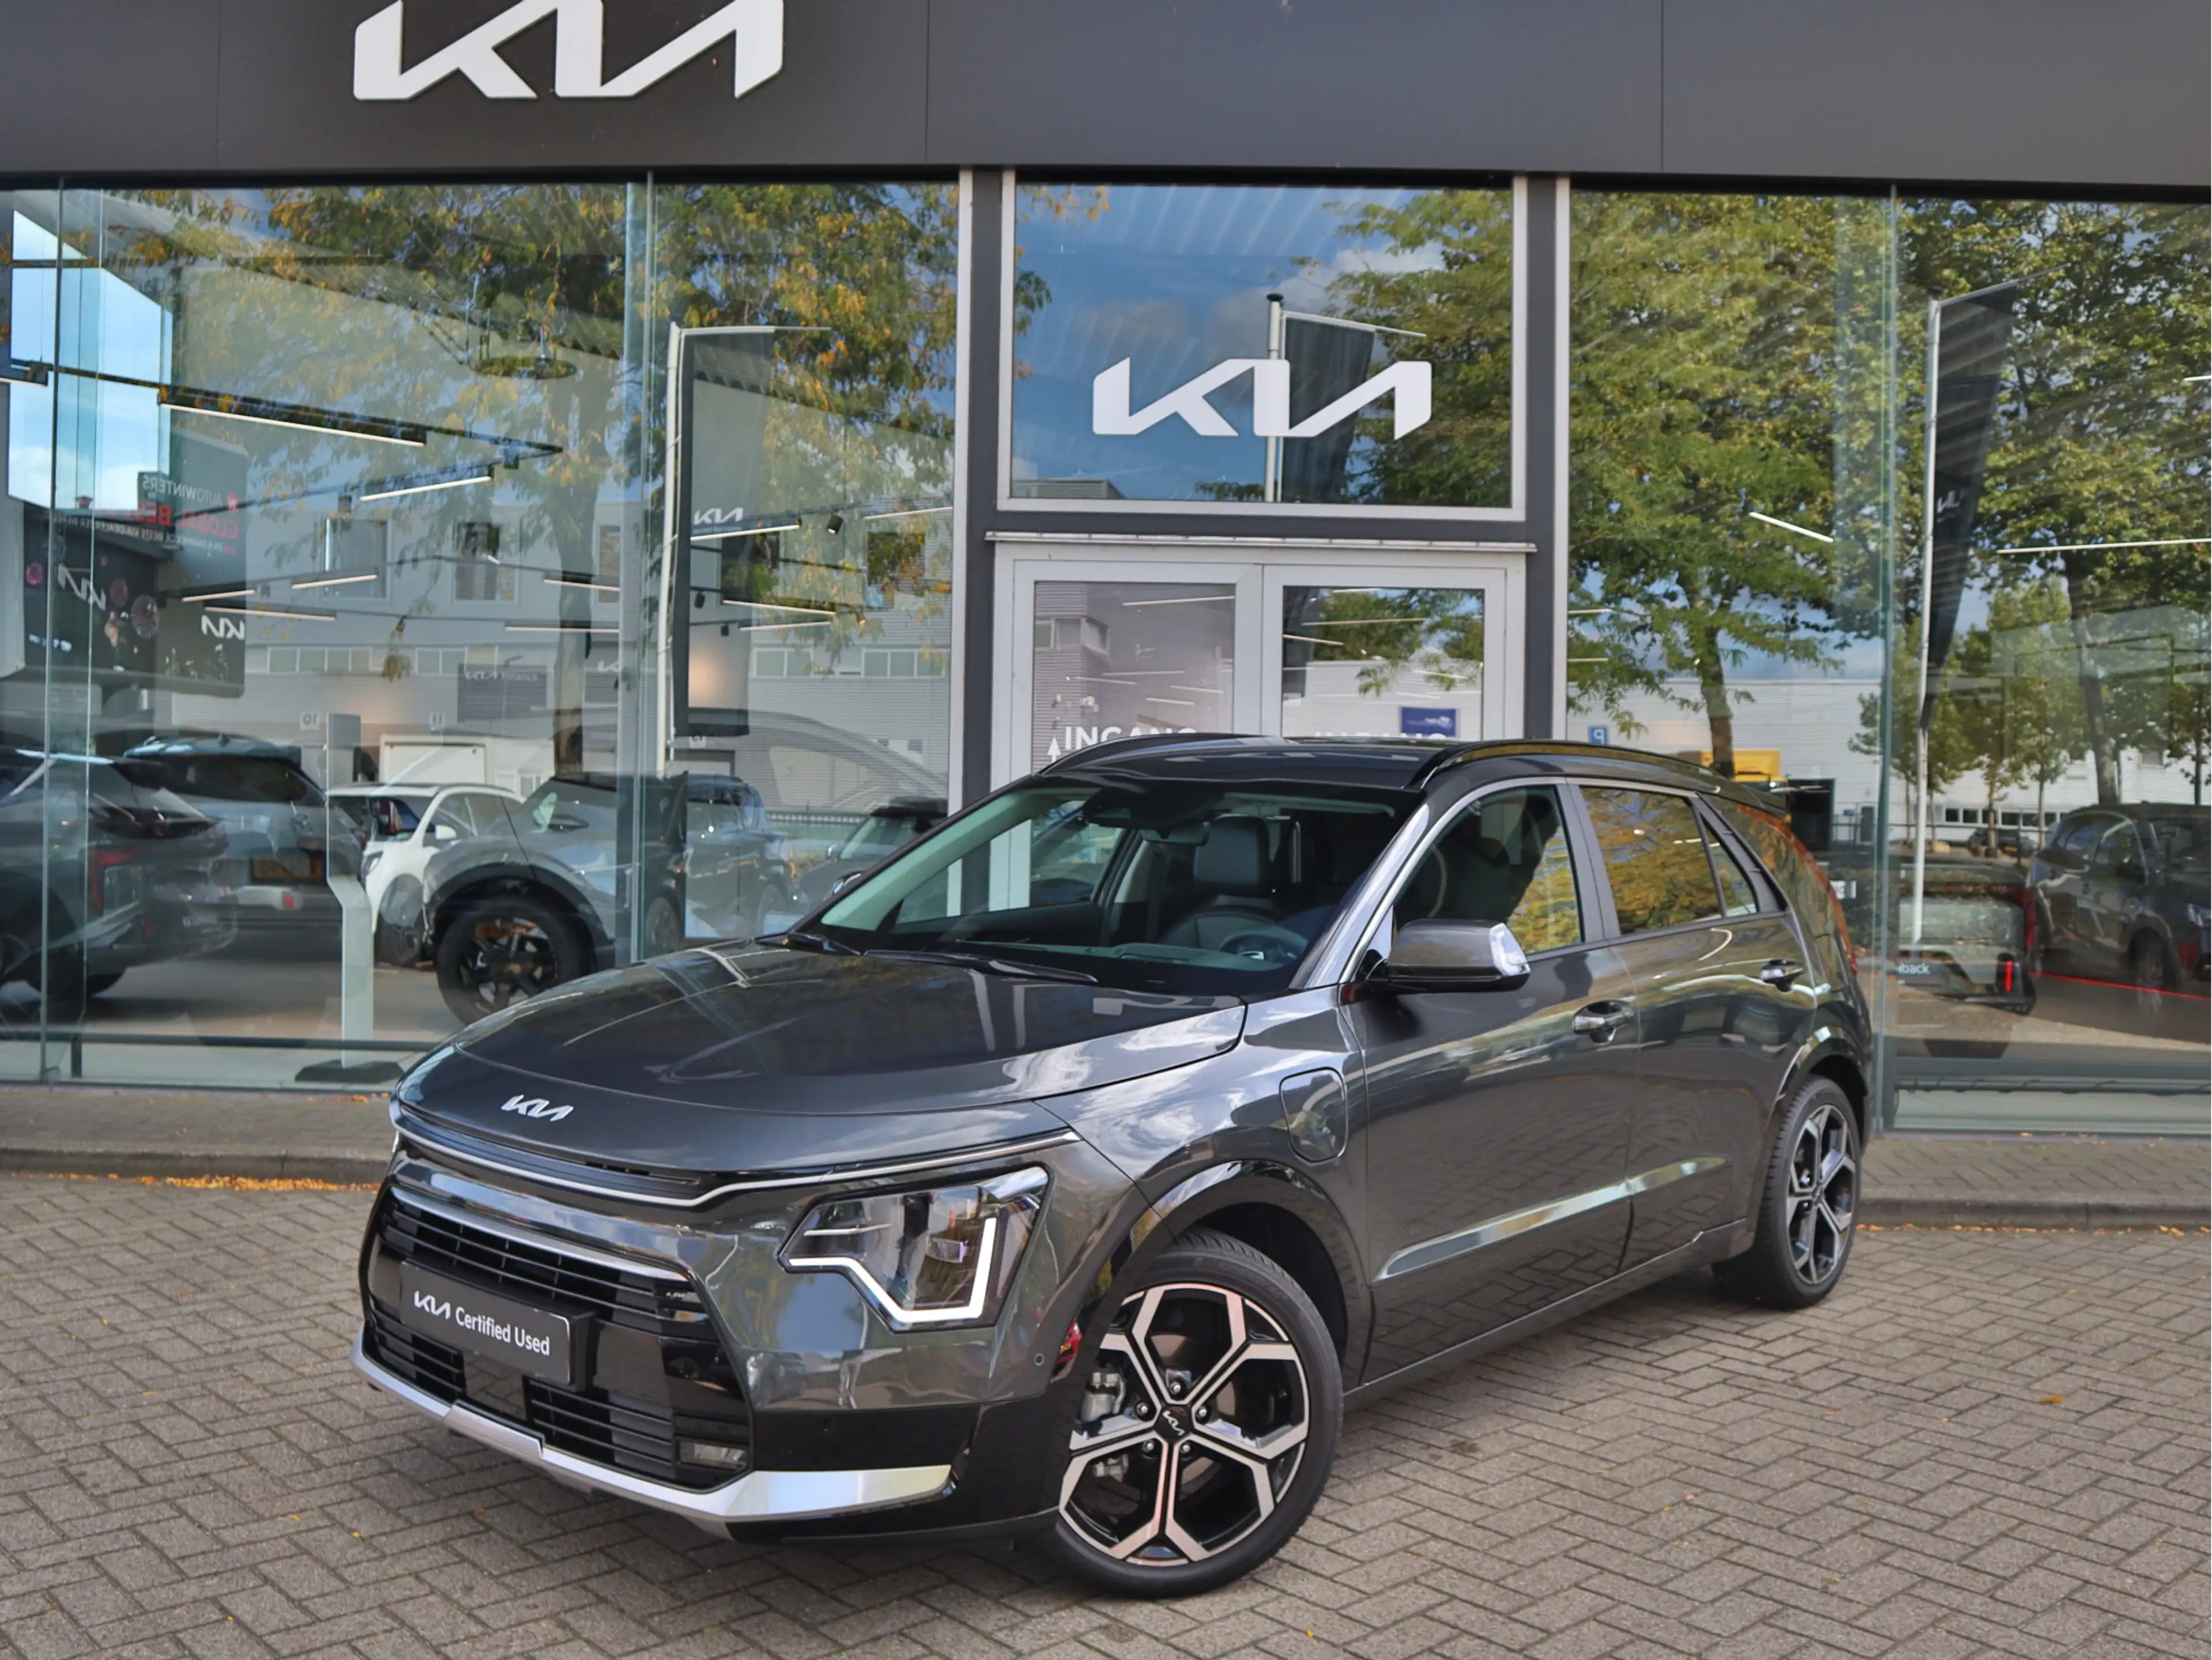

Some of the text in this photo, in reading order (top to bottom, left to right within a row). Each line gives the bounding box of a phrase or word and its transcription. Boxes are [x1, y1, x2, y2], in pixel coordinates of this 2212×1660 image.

[353, 0, 783, 100] KIA
[1093, 357, 1431, 440] KIA
[694, 507, 743, 526] KIA
[501, 1095, 574, 1122] KIA
[414, 1290, 550, 1356] KIA Certified Used
